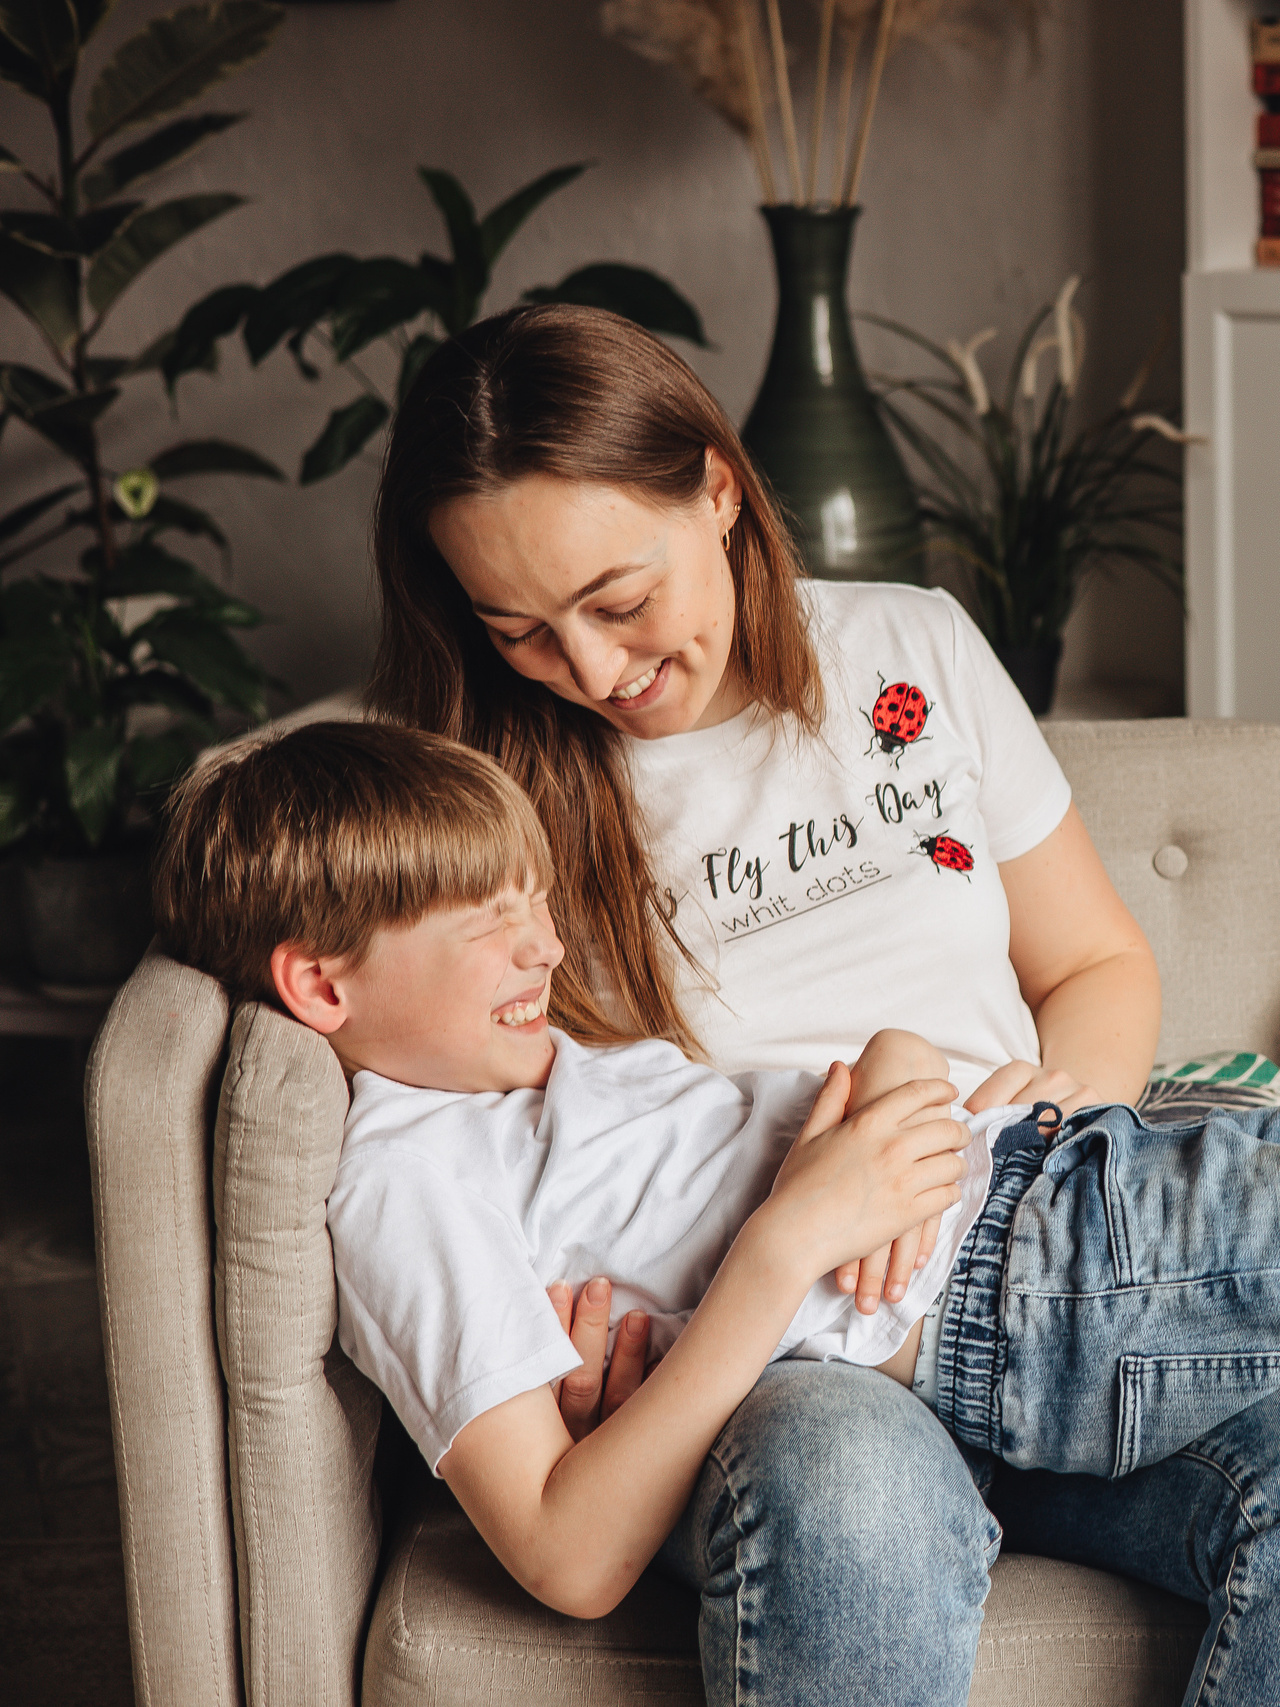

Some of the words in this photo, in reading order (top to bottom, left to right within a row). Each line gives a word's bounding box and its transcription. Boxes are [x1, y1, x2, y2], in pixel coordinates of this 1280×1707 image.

[701, 847, 770, 899] Fly
[778, 814, 864, 872] this
[865, 780, 947, 823] Day
[721, 895, 796, 933] whit
[806, 861, 880, 901] dots
